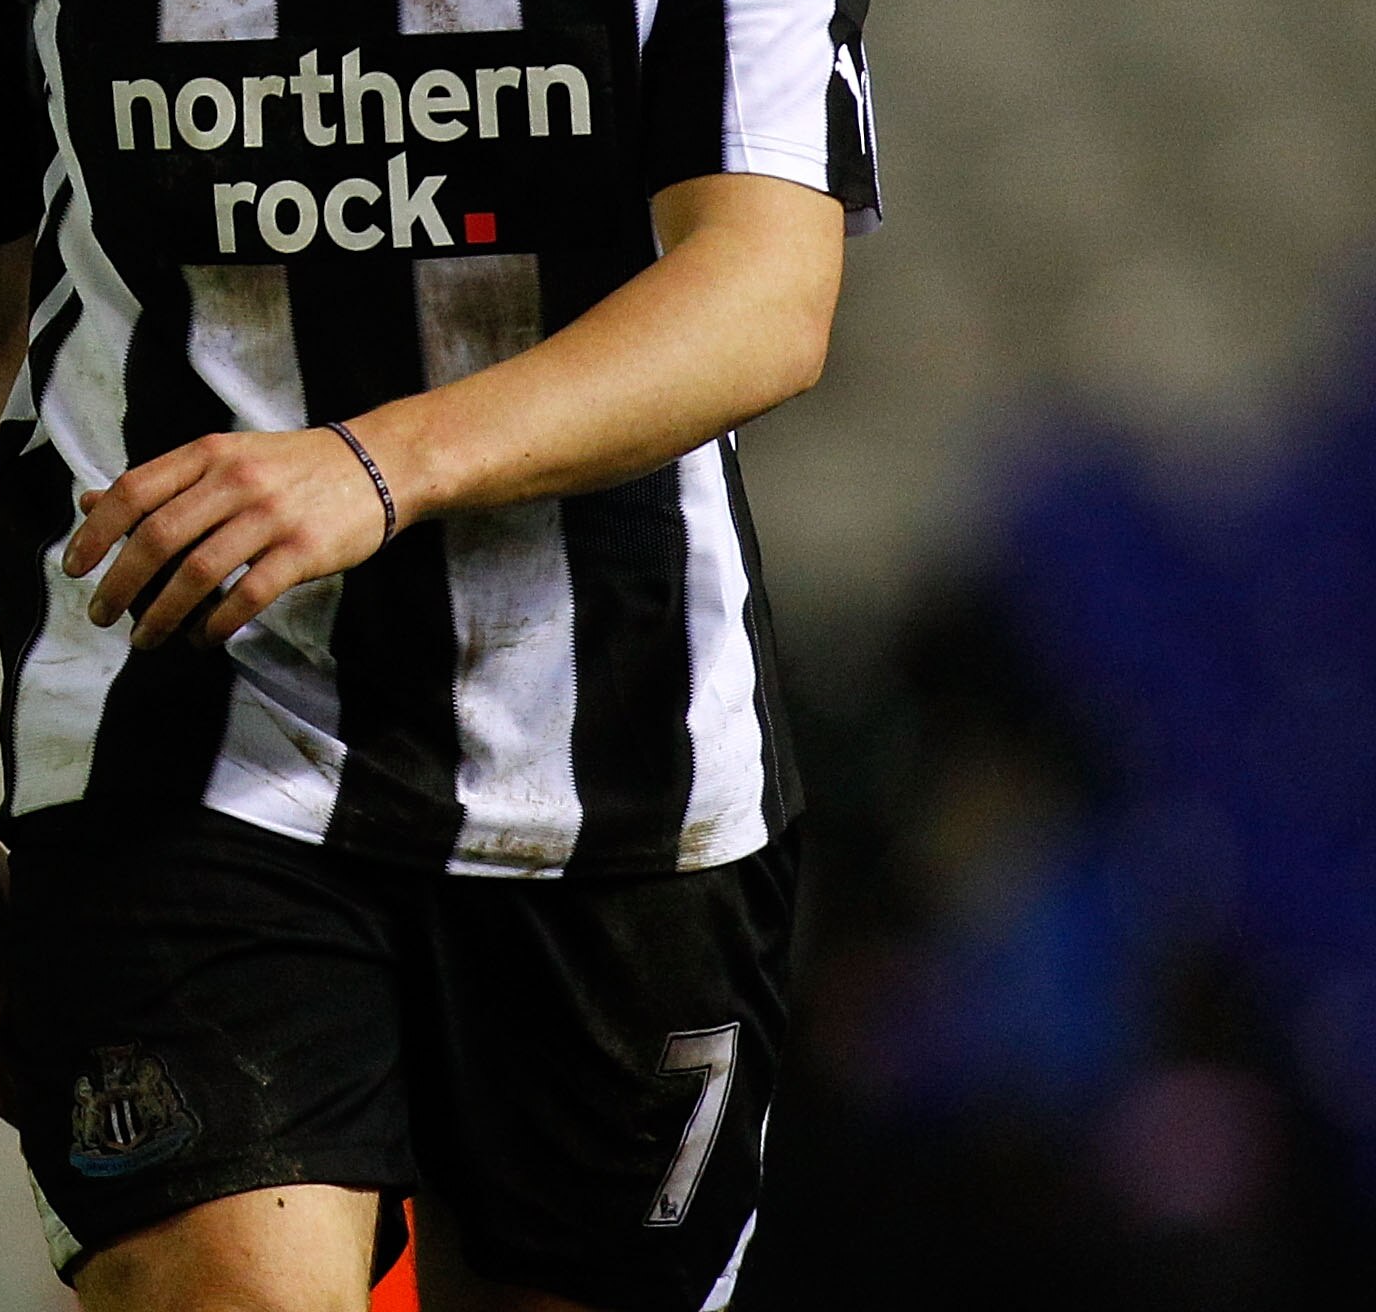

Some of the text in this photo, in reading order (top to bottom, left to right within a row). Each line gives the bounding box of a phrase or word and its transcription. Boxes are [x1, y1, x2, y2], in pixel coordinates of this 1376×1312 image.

[111, 47, 592, 150] northern
[213, 151, 497, 254] rock.
[643, 1021, 740, 1227] 7
